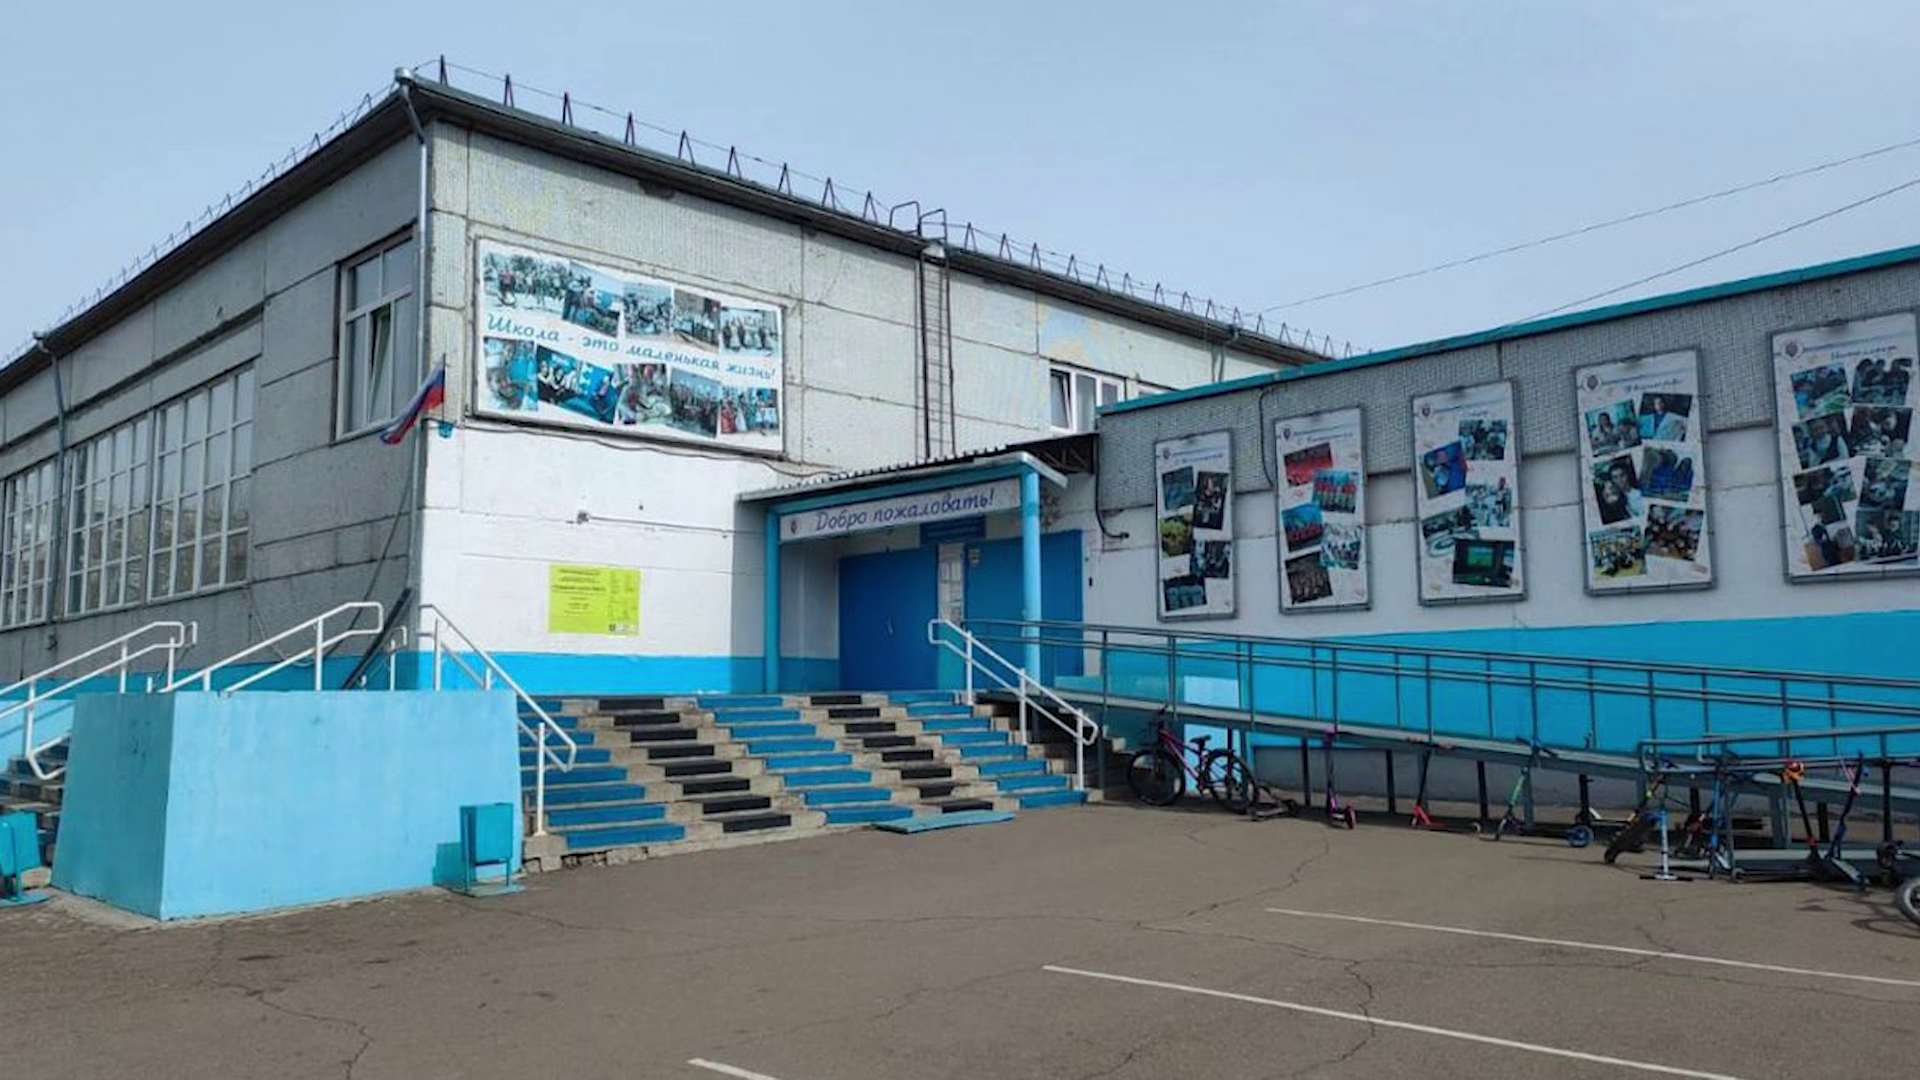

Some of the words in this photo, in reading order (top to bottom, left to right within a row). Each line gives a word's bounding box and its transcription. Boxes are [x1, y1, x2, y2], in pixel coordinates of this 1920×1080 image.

[487, 313, 560, 342] Школа
[582, 336, 620, 353] это
[625, 345, 720, 371] маленькая
[726, 363, 776, 380] жизнь!
[815, 510, 868, 532] Добро
[871, 488, 995, 523] пожаловать!
